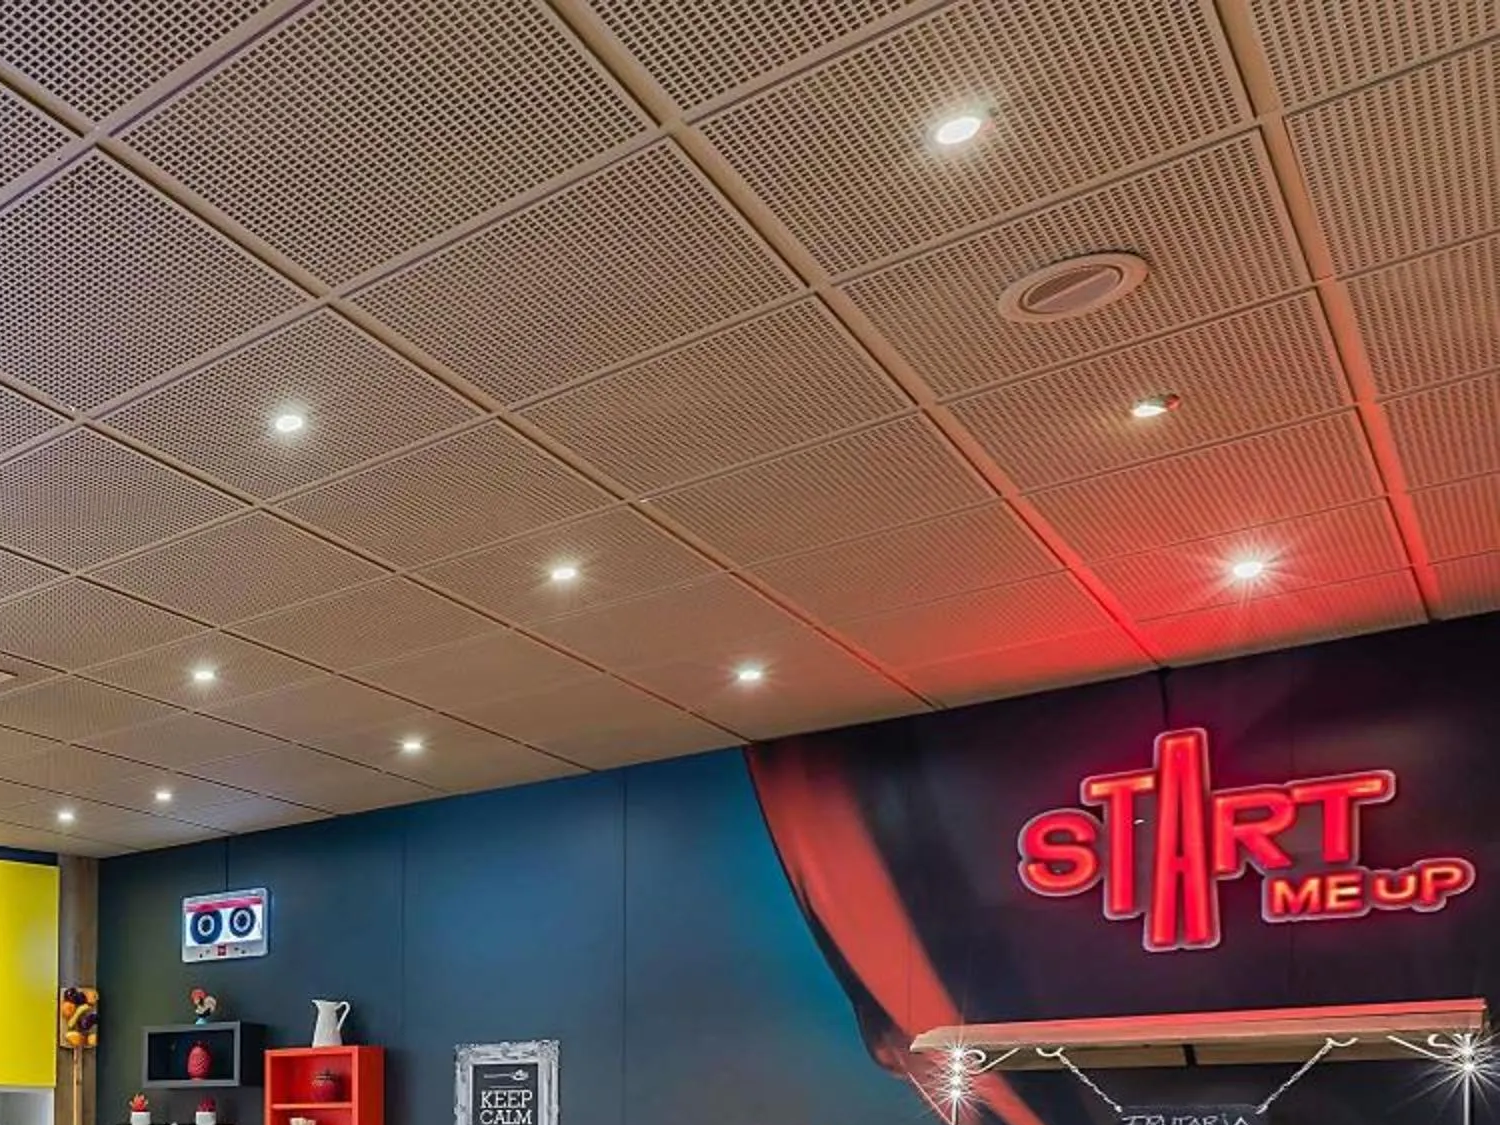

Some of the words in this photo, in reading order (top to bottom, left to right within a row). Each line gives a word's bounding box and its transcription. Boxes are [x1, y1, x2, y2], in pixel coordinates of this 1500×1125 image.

[1021, 730, 1390, 949] START
[1270, 871, 1364, 915] ME
[1373, 863, 1466, 907] UP
[480, 1090, 533, 1109] KEEP
[480, 1109, 533, 1125] CALM
